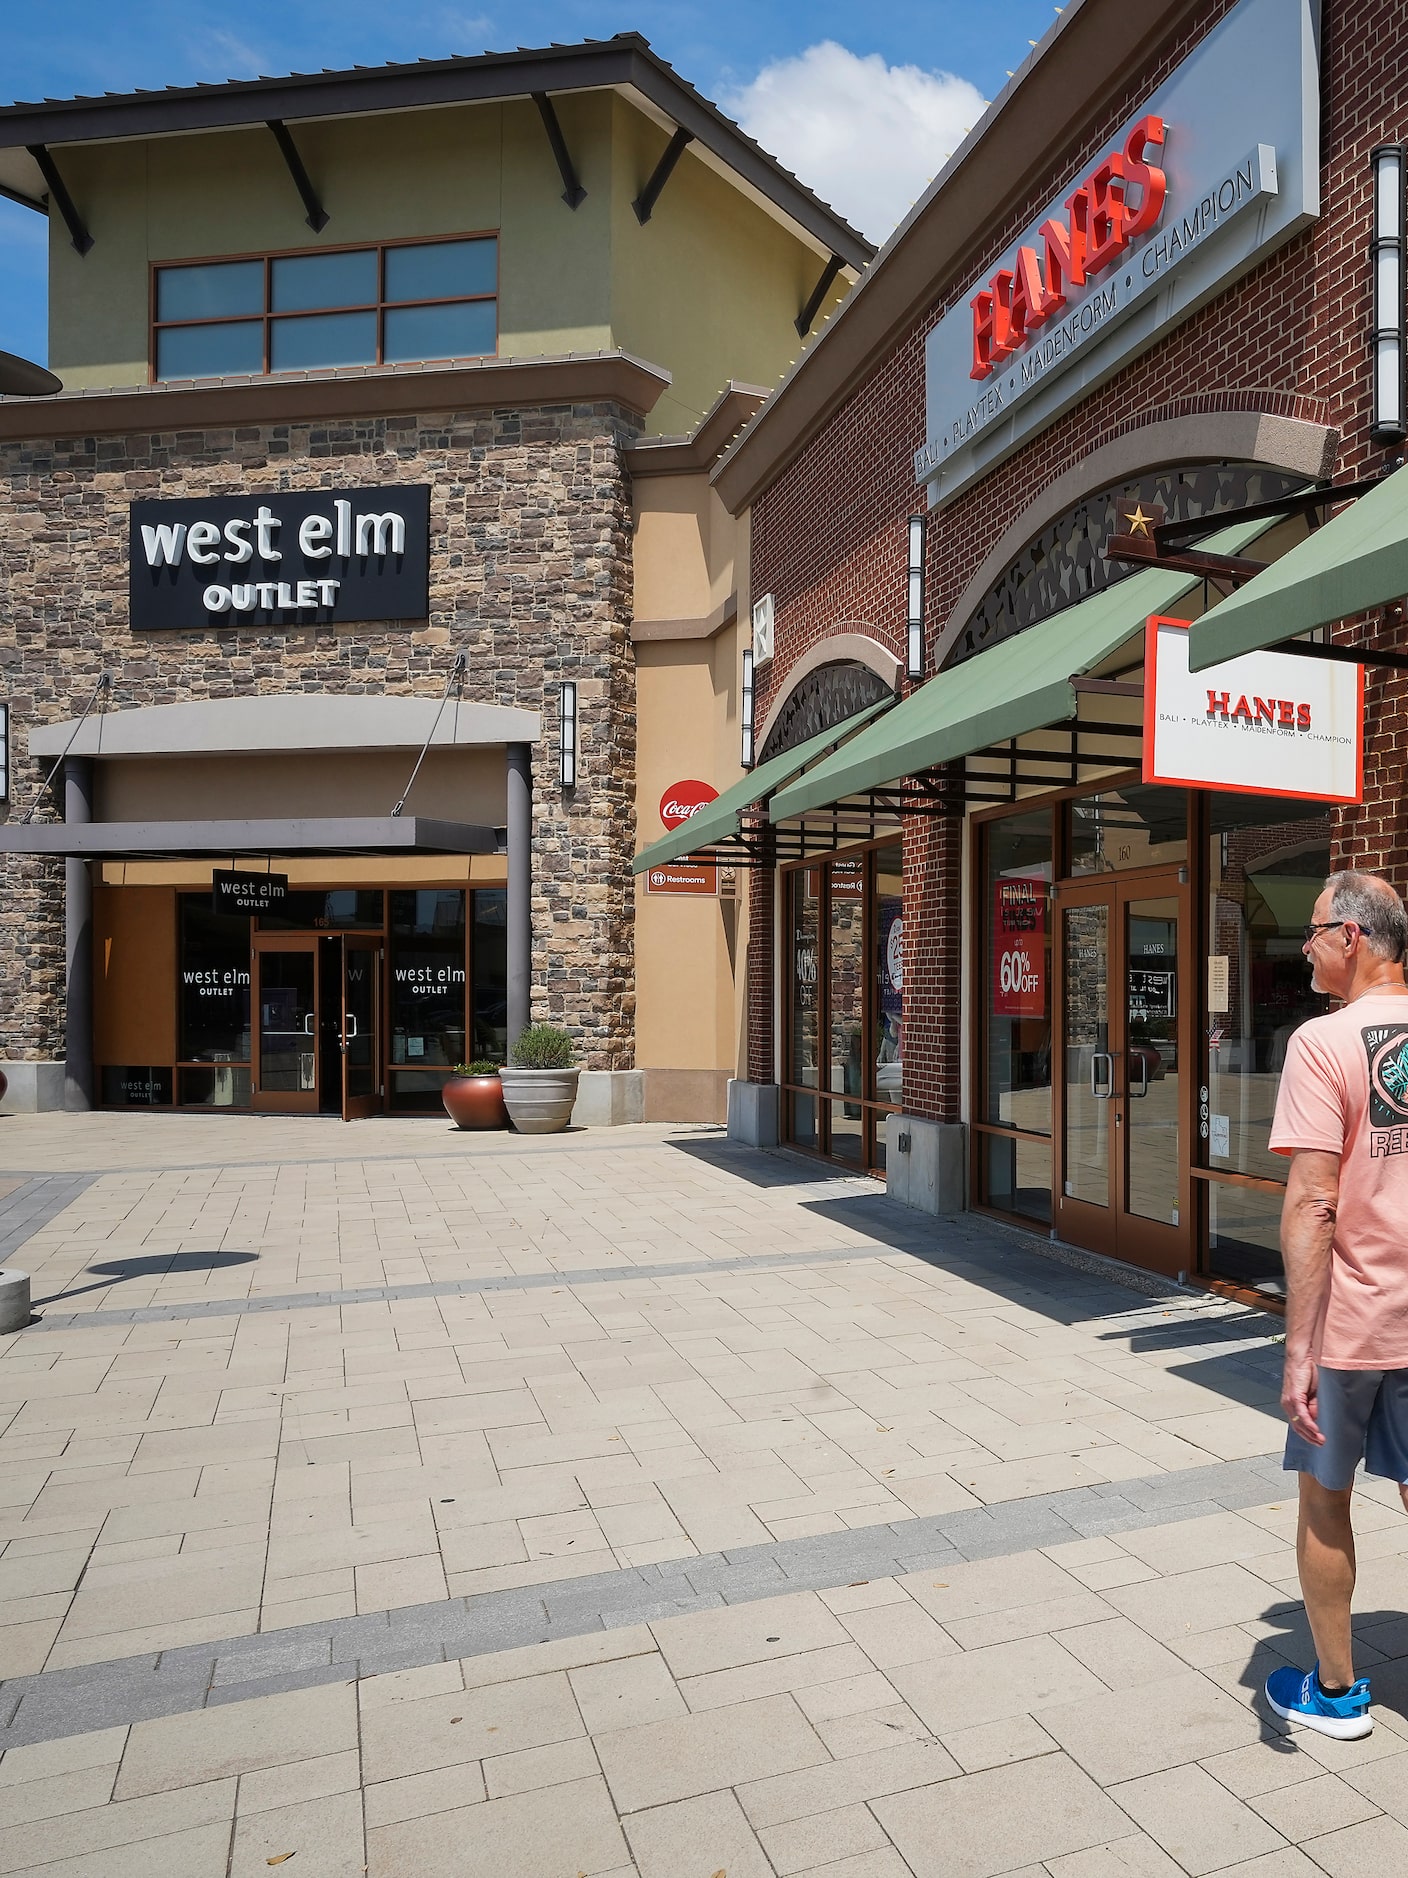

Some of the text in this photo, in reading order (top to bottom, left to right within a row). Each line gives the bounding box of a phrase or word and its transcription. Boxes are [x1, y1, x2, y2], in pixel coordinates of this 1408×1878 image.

[969, 114, 1168, 381] HANES
[915, 159, 1255, 476] BALI PLAYTEX MAIDENFORM CHAMPION
[140, 499, 406, 567] west elm
[203, 579, 341, 613] OUTLET
[1206, 690, 1311, 729] HANES
[1159, 713, 1352, 745] BALI PLAYTEX MAIDENFORM CHAMPION
[1118, 845, 1131, 861] 160
[666, 875, 706, 884] Restrooms
[220, 882, 285, 897] west elm
[1002, 883, 1037, 906] FINAL
[236, 898, 270, 907] OUTLET
[1078, 949, 1097, 958] HANES
[1143, 943, 1165, 955] HANES
[183, 968, 250, 984] west elm
[395, 966, 465, 983] west elm
[1000, 950, 1039, 993] 60% OFF
[199, 987, 233, 996] OUTLET
[412, 985, 448, 994] OUTLET
[120, 1080, 162, 1091] west elm
